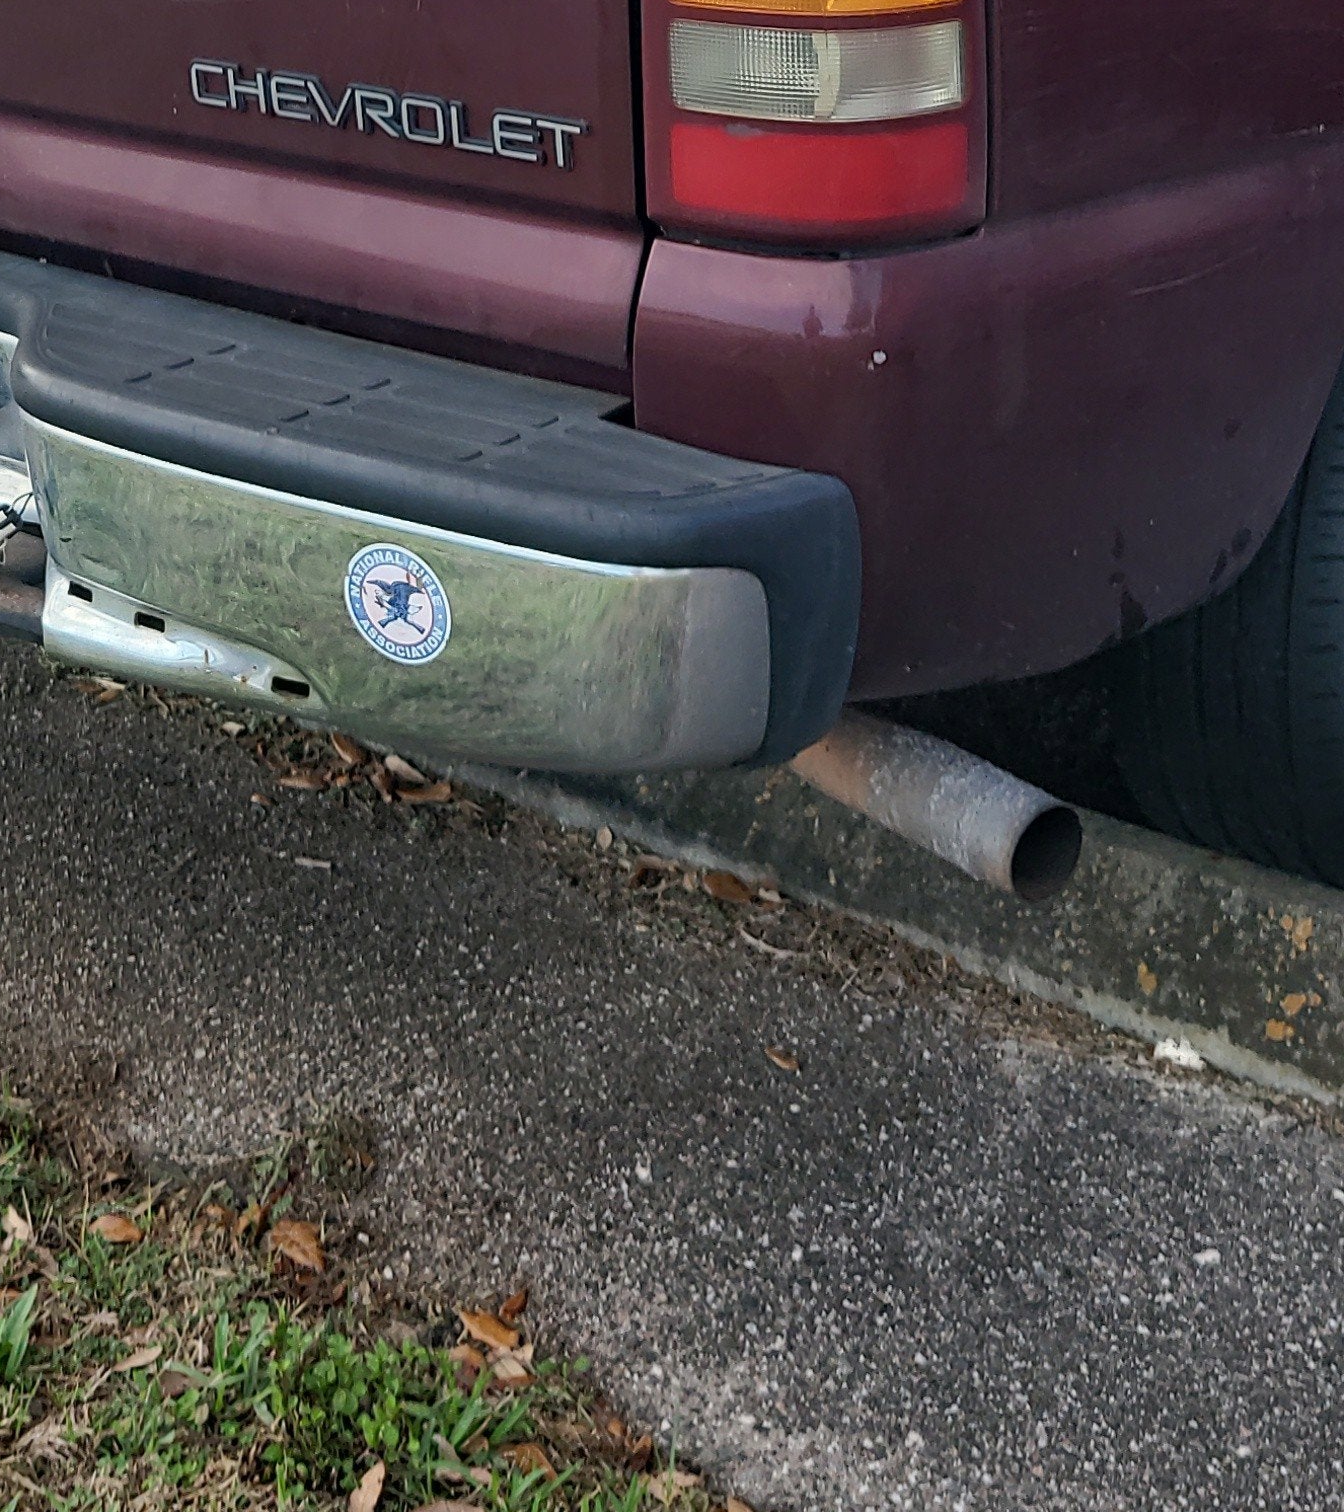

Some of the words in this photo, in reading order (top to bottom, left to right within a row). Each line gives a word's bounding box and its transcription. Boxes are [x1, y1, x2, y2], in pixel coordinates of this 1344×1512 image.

[189, 58, 588, 169] CHEVROLET
[350, 550, 404, 597] NATIONAL
[408, 560, 443, 606] RIFLE
[359, 619, 444, 659] ASSOCIATION
